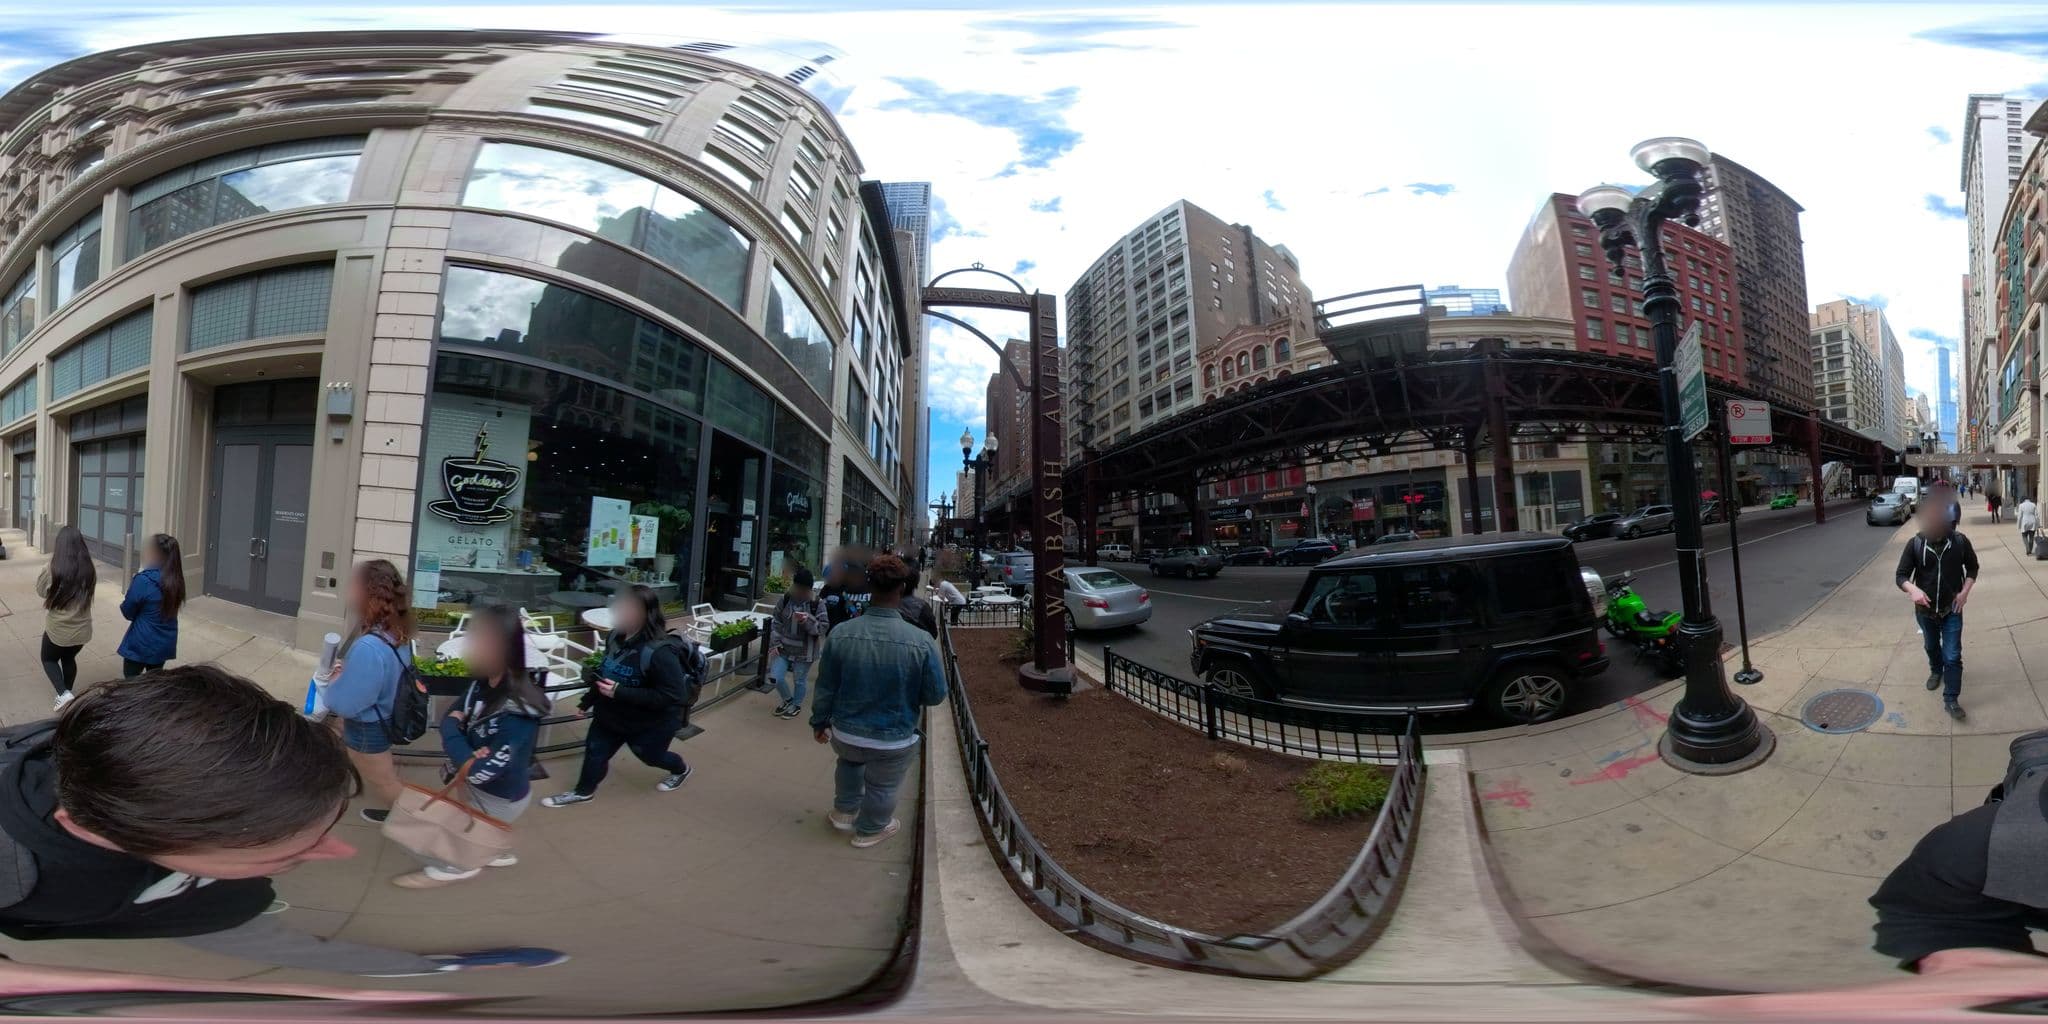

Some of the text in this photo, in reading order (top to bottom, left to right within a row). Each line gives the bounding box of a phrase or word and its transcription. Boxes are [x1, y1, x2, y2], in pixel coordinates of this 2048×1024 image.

[1040, 308, 1065, 617] WABASH AVENUE
[450, 473, 504, 492] Goddess
[448, 535, 494, 546] GELATO
